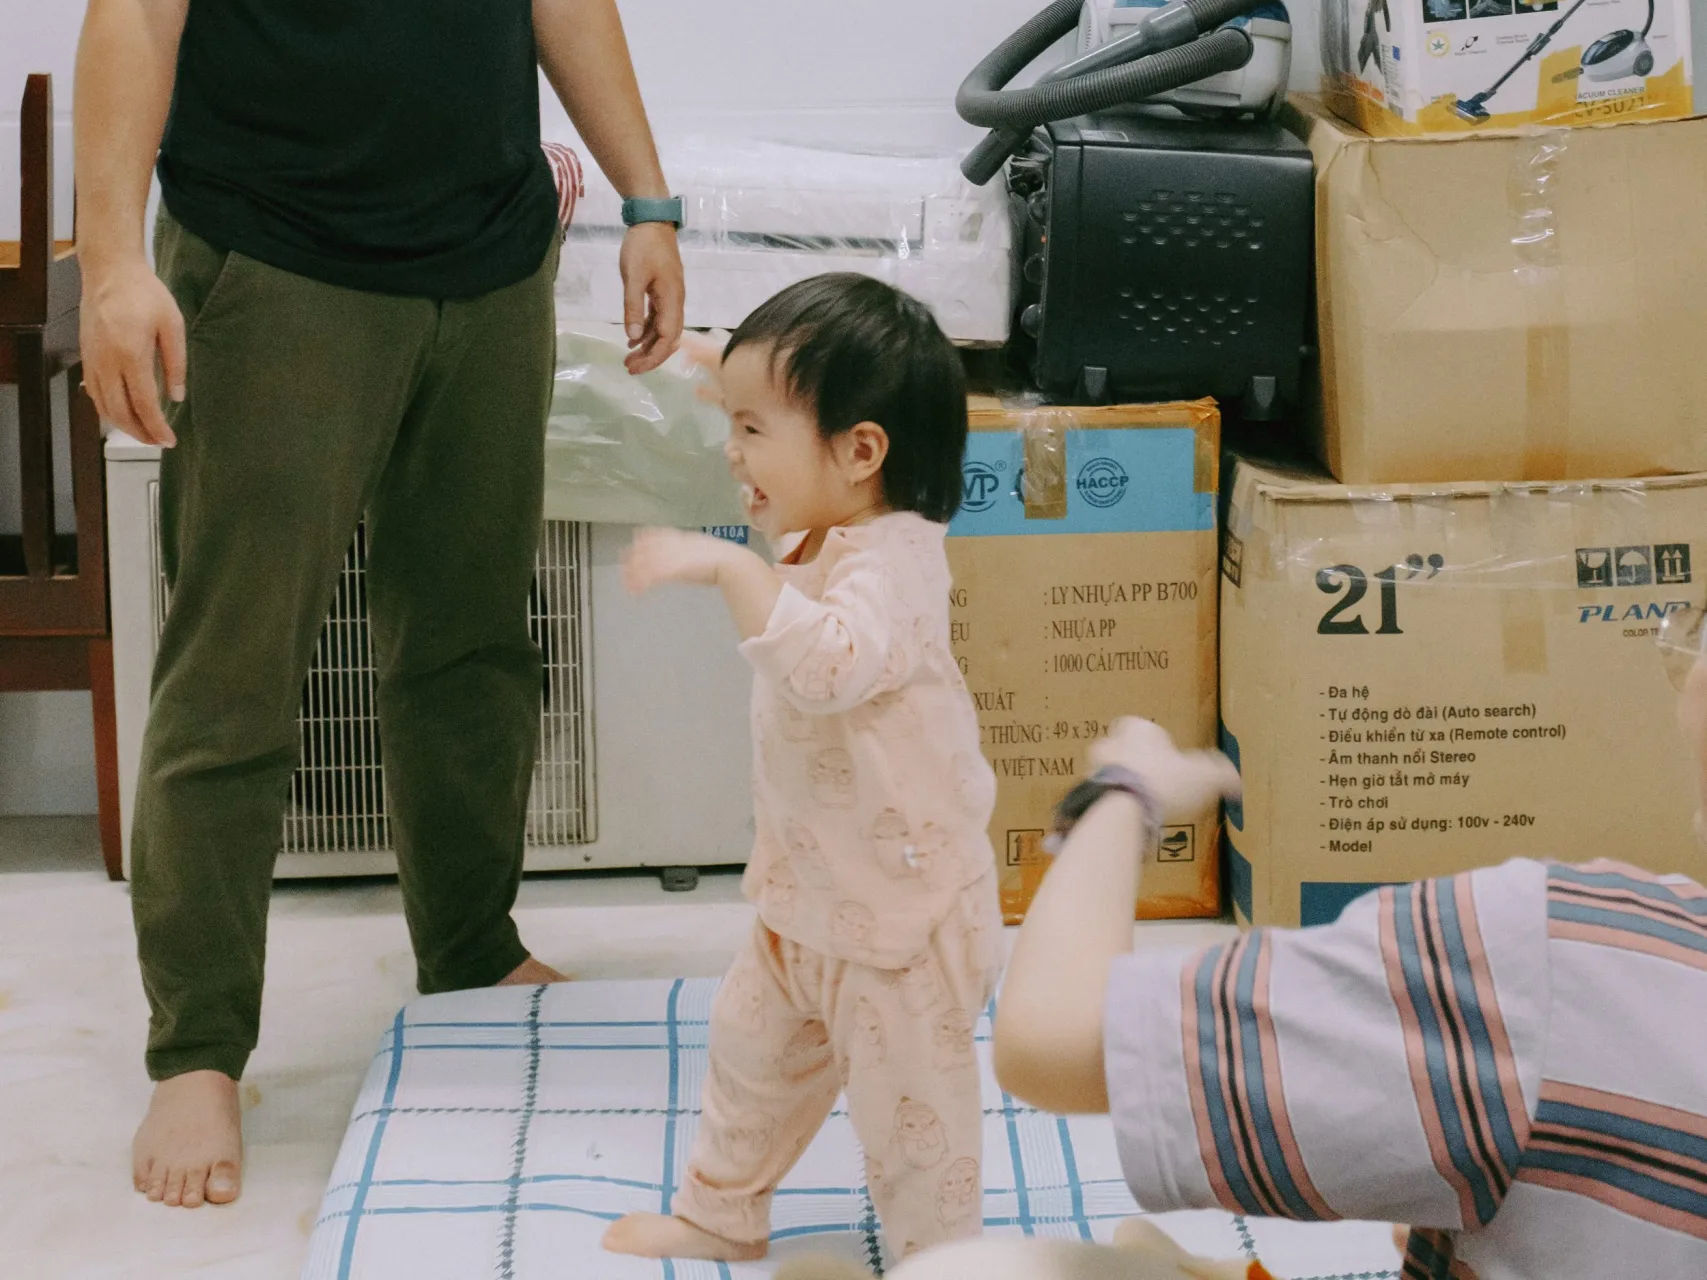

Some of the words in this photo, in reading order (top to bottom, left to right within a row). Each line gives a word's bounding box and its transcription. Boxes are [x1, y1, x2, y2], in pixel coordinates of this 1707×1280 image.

[1577, 90, 1606, 99] ACUUM
[1607, 86, 1645, 96] CLEANER
[1076, 476, 1129, 490] HACCP
[1052, 585, 1068, 605] LY
[1132, 583, 1152, 602] PP
[1157, 581, 1198, 601] B700
[1100, 619, 1116, 637] PP
[1623, 628, 1648, 637] COLOR
[1053, 654, 1083, 673] 1000
[1328, 686, 1347, 698] Đa
[1352, 685, 1369, 700] hệ
[1329, 708, 1348, 723] Tự
[1352, 707, 1389, 723] động
[1393, 706, 1411, 720] dò
[1416, 705, 1438, 719] đài
[1442, 705, 1480, 722] (Auto
[1484, 703, 1536, 719] search)
[989, 719, 1042, 744] THÙNG
[1053, 721, 1068, 740] 49
[1072, 726, 1080, 738] x
[1084, 720, 1099, 739] 39
[1411, 728, 1425, 741] từ
[1429, 731, 1445, 741] xa
[1449, 728, 1508, 744] (Remote
[1512, 724, 1566, 740] control)
[1328, 749, 1352, 764] Âm
[1357, 752, 1398, 764] thanh
[1430, 751, 1476, 763] Stereo
[1001, 756, 1036, 780] VIỆT
[1038, 757, 1074, 776] NAM
[1329, 774, 1357, 789] Hẹn
[1363, 773, 1385, 789] giờ
[1440, 772, 1469, 787] máy
[1329, 796, 1352, 808] Trò
[1358, 796, 1388, 808] chơi
[1329, 818, 1361, 832] Điện
[1366, 817, 1384, 833] áp
[1411, 818, 1452, 832] dụng:
[1458, 816, 1490, 828] 100v
[1503, 815, 1535, 826] 240v
[1329, 840, 1372, 852] Model
